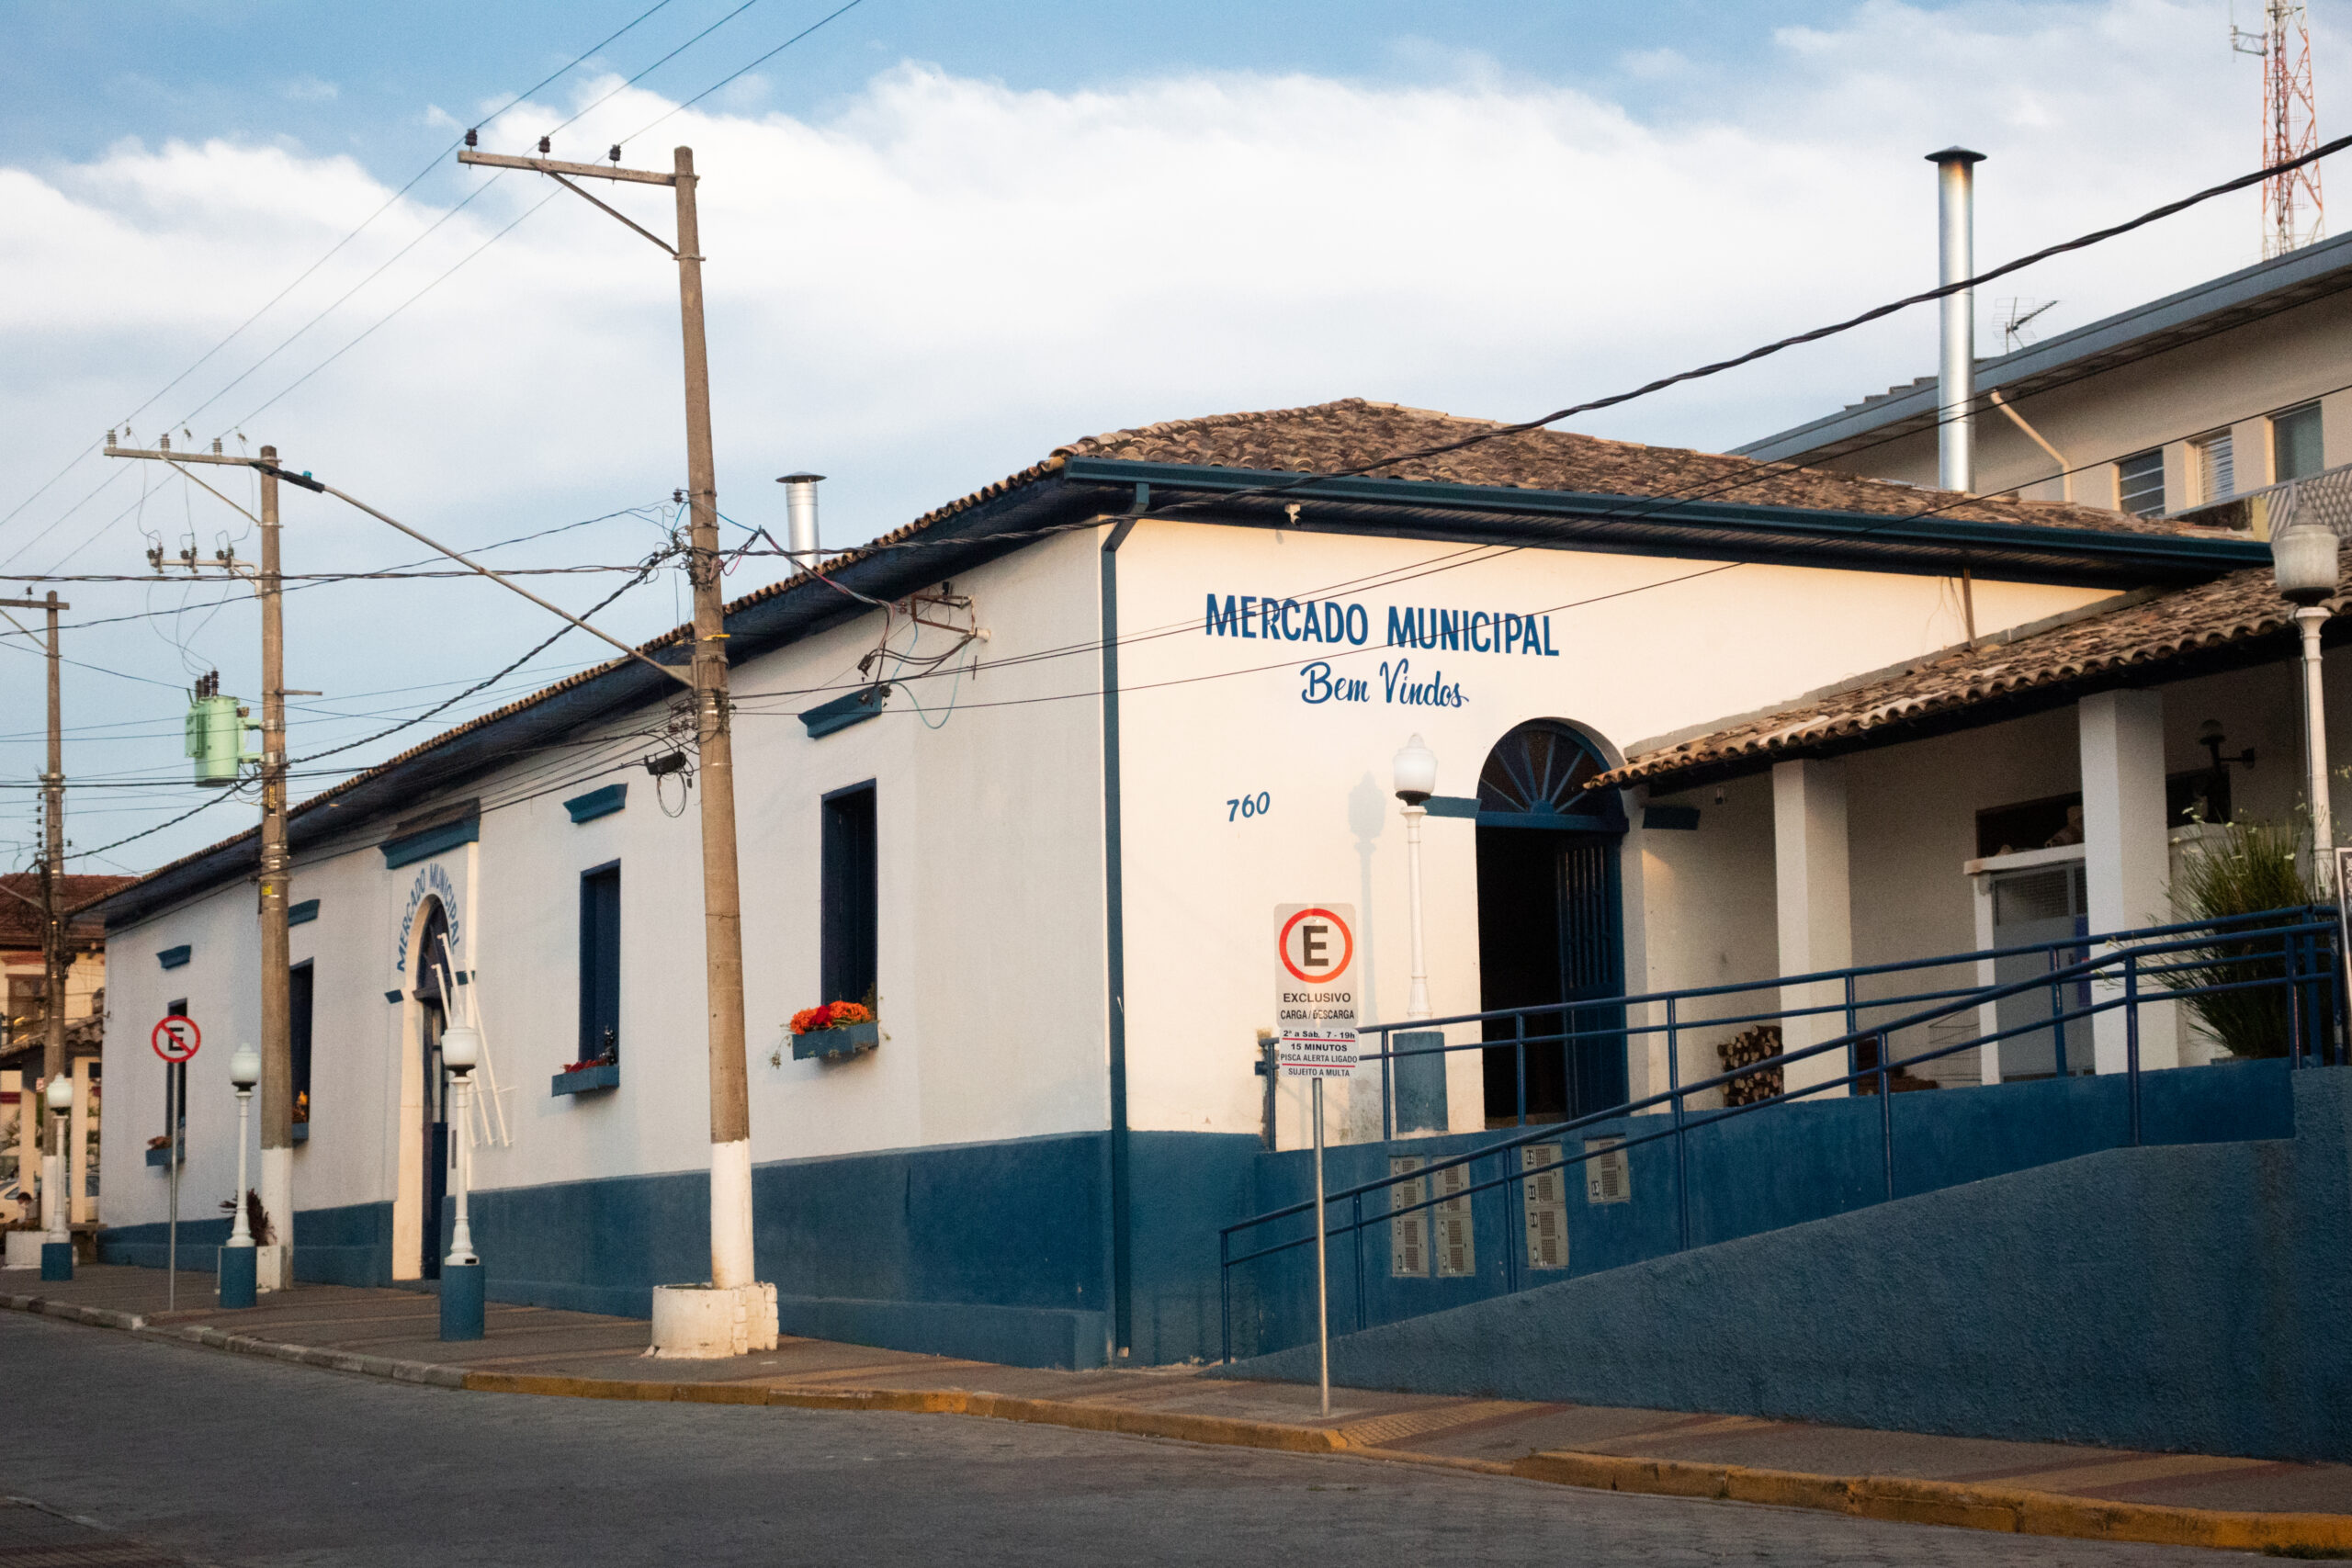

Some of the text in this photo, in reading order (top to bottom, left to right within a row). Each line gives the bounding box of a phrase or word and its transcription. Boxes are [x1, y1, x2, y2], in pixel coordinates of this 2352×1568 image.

[1205, 593, 1560, 657] MERCADO MUNICIPAL
[1300, 659, 1470, 708] Bem Vindos
[1227, 791, 1271, 822] 760
[397, 863, 459, 972] MERCADO MUNICIPAL
[1303, 925, 1329, 966] E
[1283, 992, 1351, 1003] EXCLUSIVO
[1280, 1010, 1307, 1020] CARGA
[1312, 1010, 1355, 1020] DESCARGA
[168, 1027, 184, 1051] E
[1305, 1043, 1348, 1052] MINUTOS
[1288, 1067, 1317, 1076] SUJEITO
[1326, 1068, 1351, 1077] MULTA
